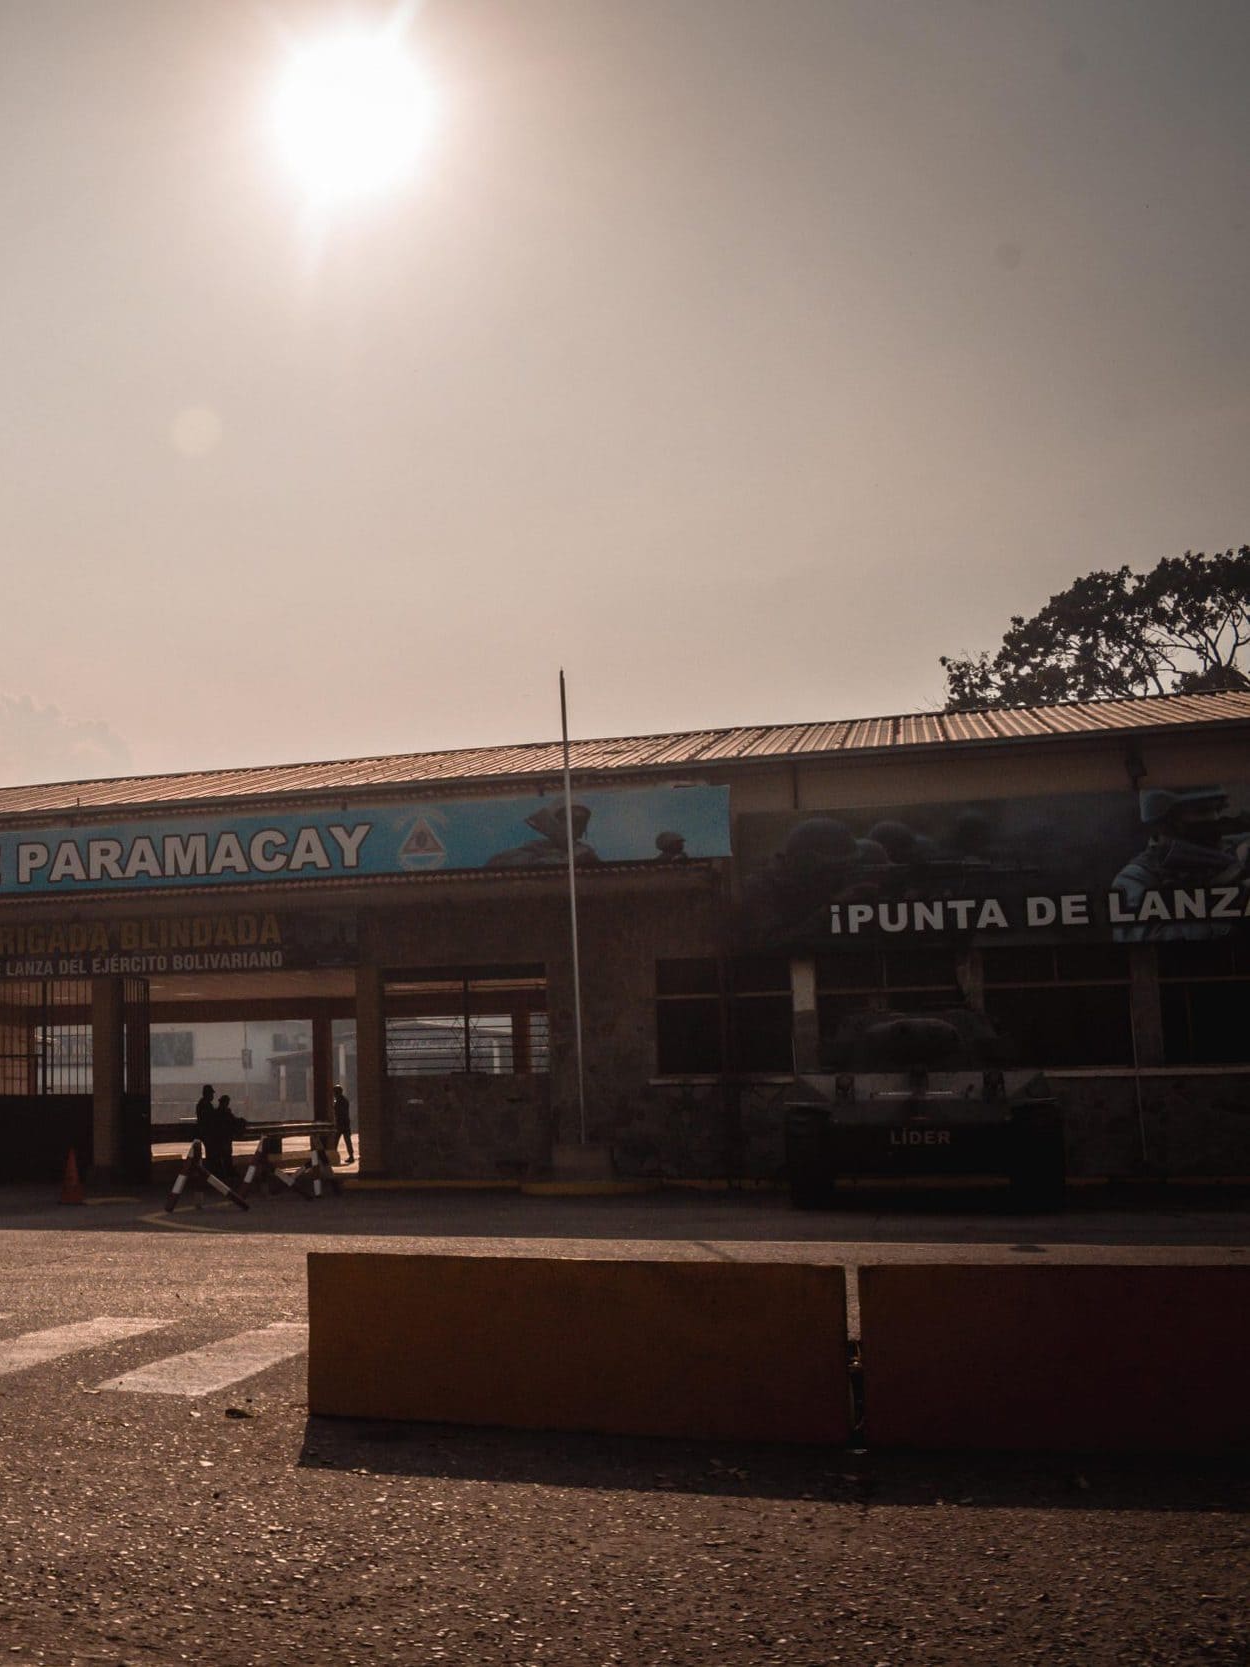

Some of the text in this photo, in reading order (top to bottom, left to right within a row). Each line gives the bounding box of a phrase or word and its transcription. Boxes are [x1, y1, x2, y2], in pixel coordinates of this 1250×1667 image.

[17, 824, 372, 883] PARAMACAY
[830, 886, 1250, 934] ¡PUNTA DE LANZ
[120, 913, 282, 949] BLINDADA
[5, 958, 54, 978] LANZA
[58, 956, 87, 975] DEL
[92, 952, 168, 975] EJÉRCITO
[173, 951, 282, 971] BOLIVARIANO
[890, 1127, 951, 1145] LÍDER
